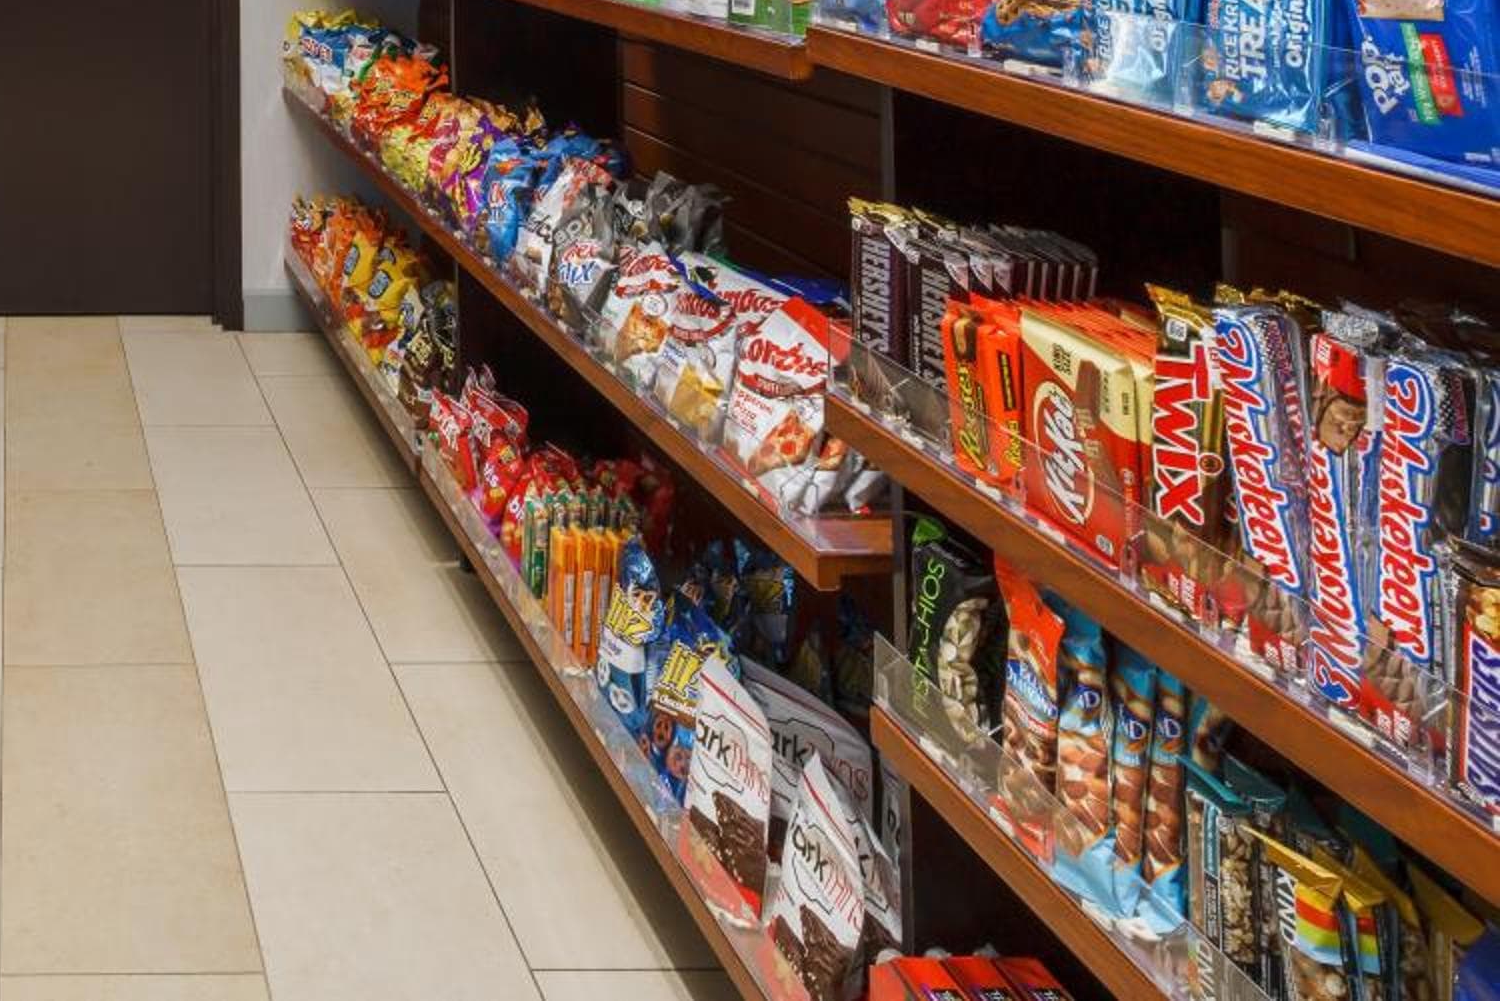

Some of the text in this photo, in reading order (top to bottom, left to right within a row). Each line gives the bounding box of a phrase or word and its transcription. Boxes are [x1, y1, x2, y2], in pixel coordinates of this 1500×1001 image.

[1224, 32, 1240, 80] RICE
[861, 236, 891, 353] HERSHEY'S
[1219, 361, 1299, 586] Musketeers
[1275, 865, 1298, 945] KIND
